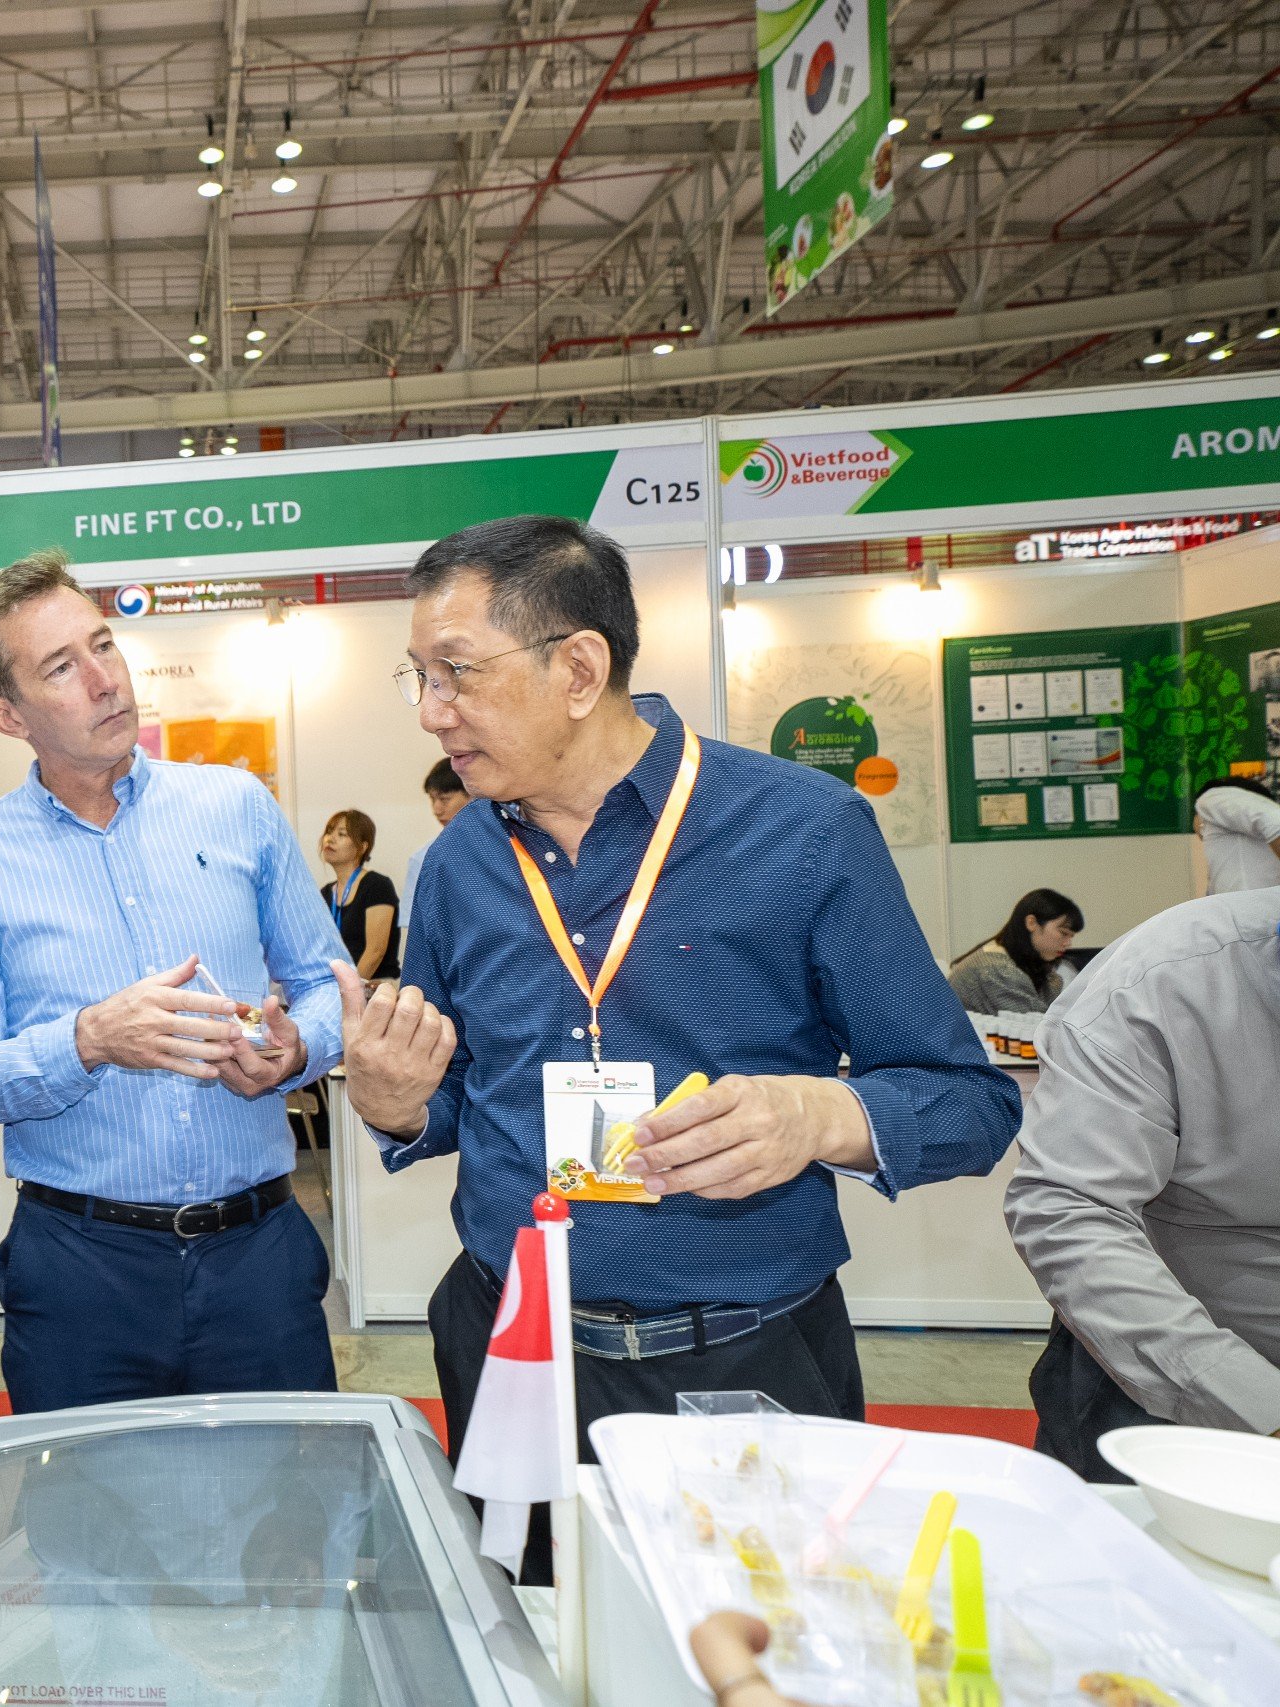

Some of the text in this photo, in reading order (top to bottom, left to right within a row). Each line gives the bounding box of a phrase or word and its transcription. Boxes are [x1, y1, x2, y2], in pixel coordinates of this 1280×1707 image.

[791, 446, 890, 468] Vietfood
[791, 466, 891, 485] &Beverage
[626, 477, 701, 505] C125
[75, 501, 302, 538] FINE FT CO., LTD
[1060, 531, 1099, 545] Korea
[154, 585, 194, 598] Ministry
[193, 583, 206, 595] of
[154, 597, 264, 613] Food and Rural Affairs
[31, 1685, 66, 1697] LOAD
[70, 1686, 103, 1698] OVER
[139, 1687, 167, 1699] LINE
